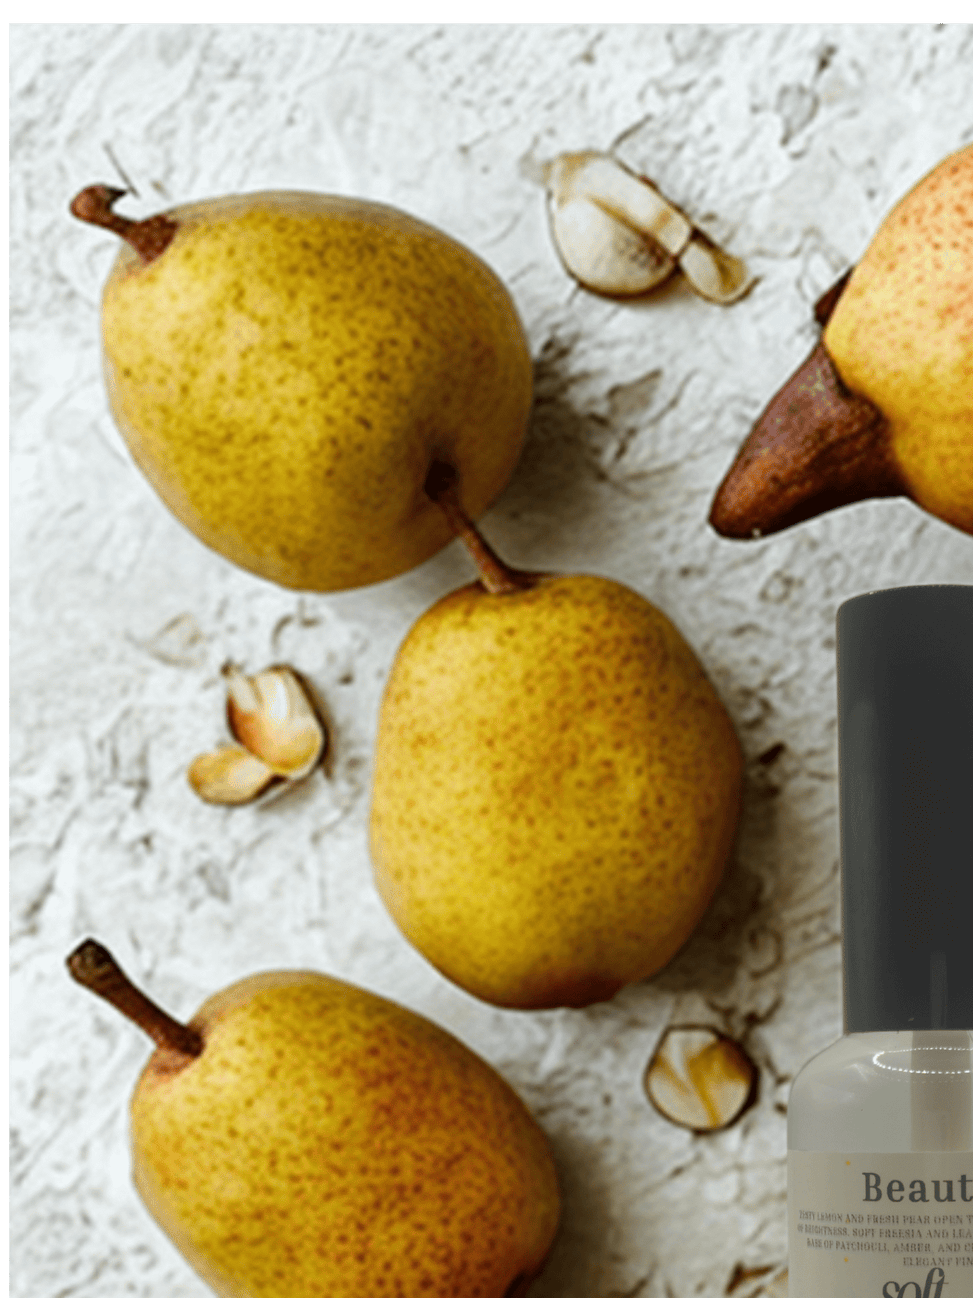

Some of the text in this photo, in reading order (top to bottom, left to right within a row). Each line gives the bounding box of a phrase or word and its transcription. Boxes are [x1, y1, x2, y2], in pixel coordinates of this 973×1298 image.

[816, 1211, 843, 1223] LEMON
[845, 1213, 865, 1224] AND
[867, 1214, 899, 1224] FRESH
[902, 1214, 931, 1225] PEAR
[933, 1214, 963, 1225] OPEN
[852, 1227, 876, 1238] SOFT
[879, 1228, 923, 1239] FREESIA
[925, 1229, 949, 1239] AND
[806, 1237, 822, 1248] BASE
[823, 1239, 833, 1250] OF
[835, 1240, 890, 1254] PATCHOULI,
[937, 1242, 961, 1253] AND
[902, 1256, 953, 1267] ELEGANT
